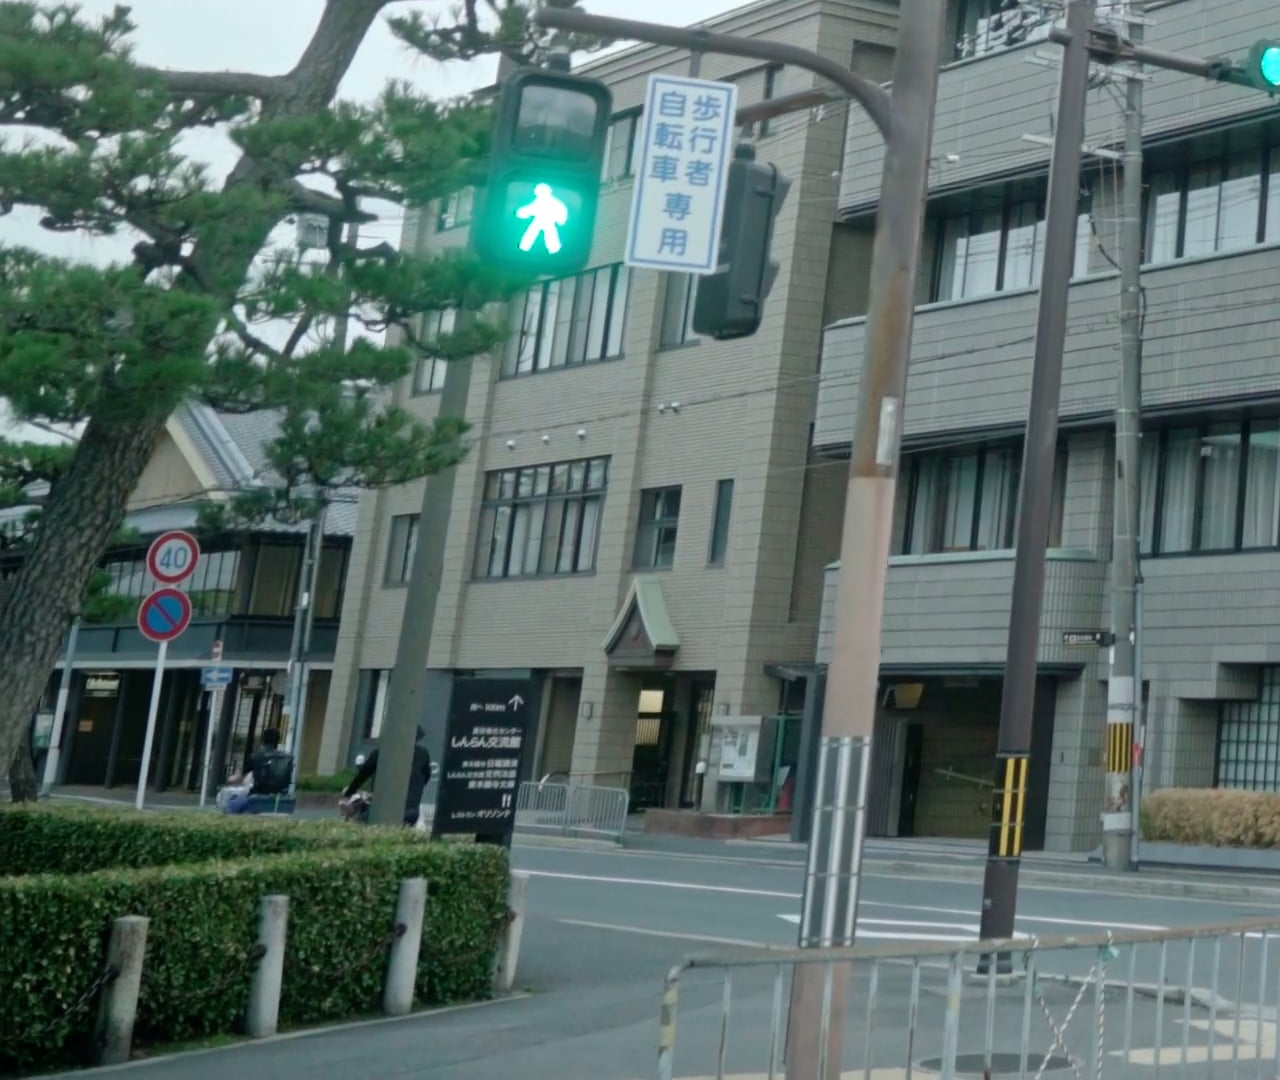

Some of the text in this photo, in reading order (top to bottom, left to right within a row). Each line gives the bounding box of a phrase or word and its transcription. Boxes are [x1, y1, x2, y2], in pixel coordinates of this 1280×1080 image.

[650, 90, 687, 183] 自転車
[684, 95, 722, 187] 歩行者
[658, 192, 693, 256] 専用
[159, 547, 188, 569] 40
